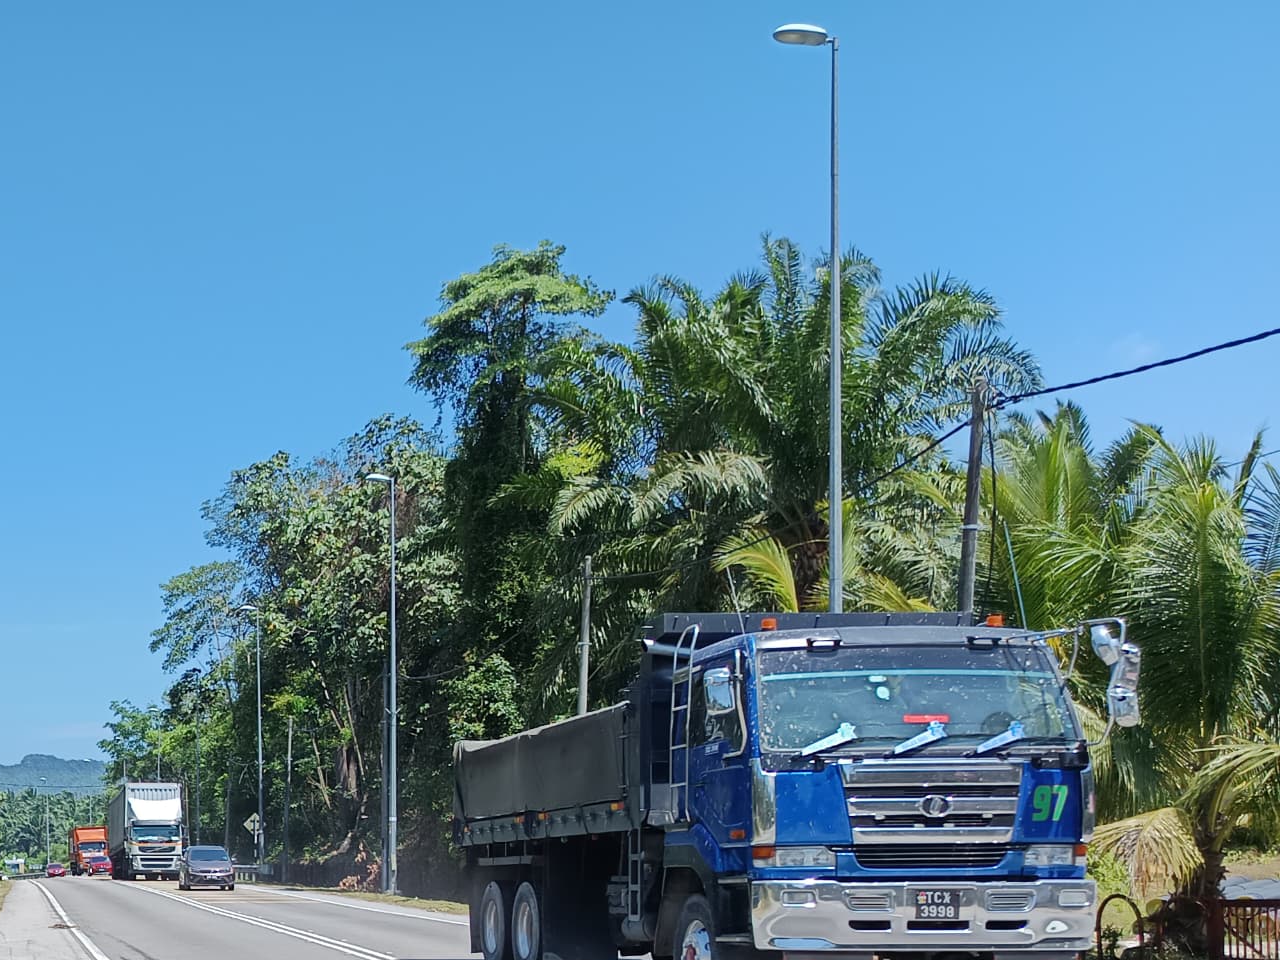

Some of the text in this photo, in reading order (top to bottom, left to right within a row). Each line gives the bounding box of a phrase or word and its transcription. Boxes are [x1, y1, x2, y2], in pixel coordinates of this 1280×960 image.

[1032, 785, 1068, 821] 97
[926, 891, 951, 904] TCX
[920, 905, 954, 918] 3998
